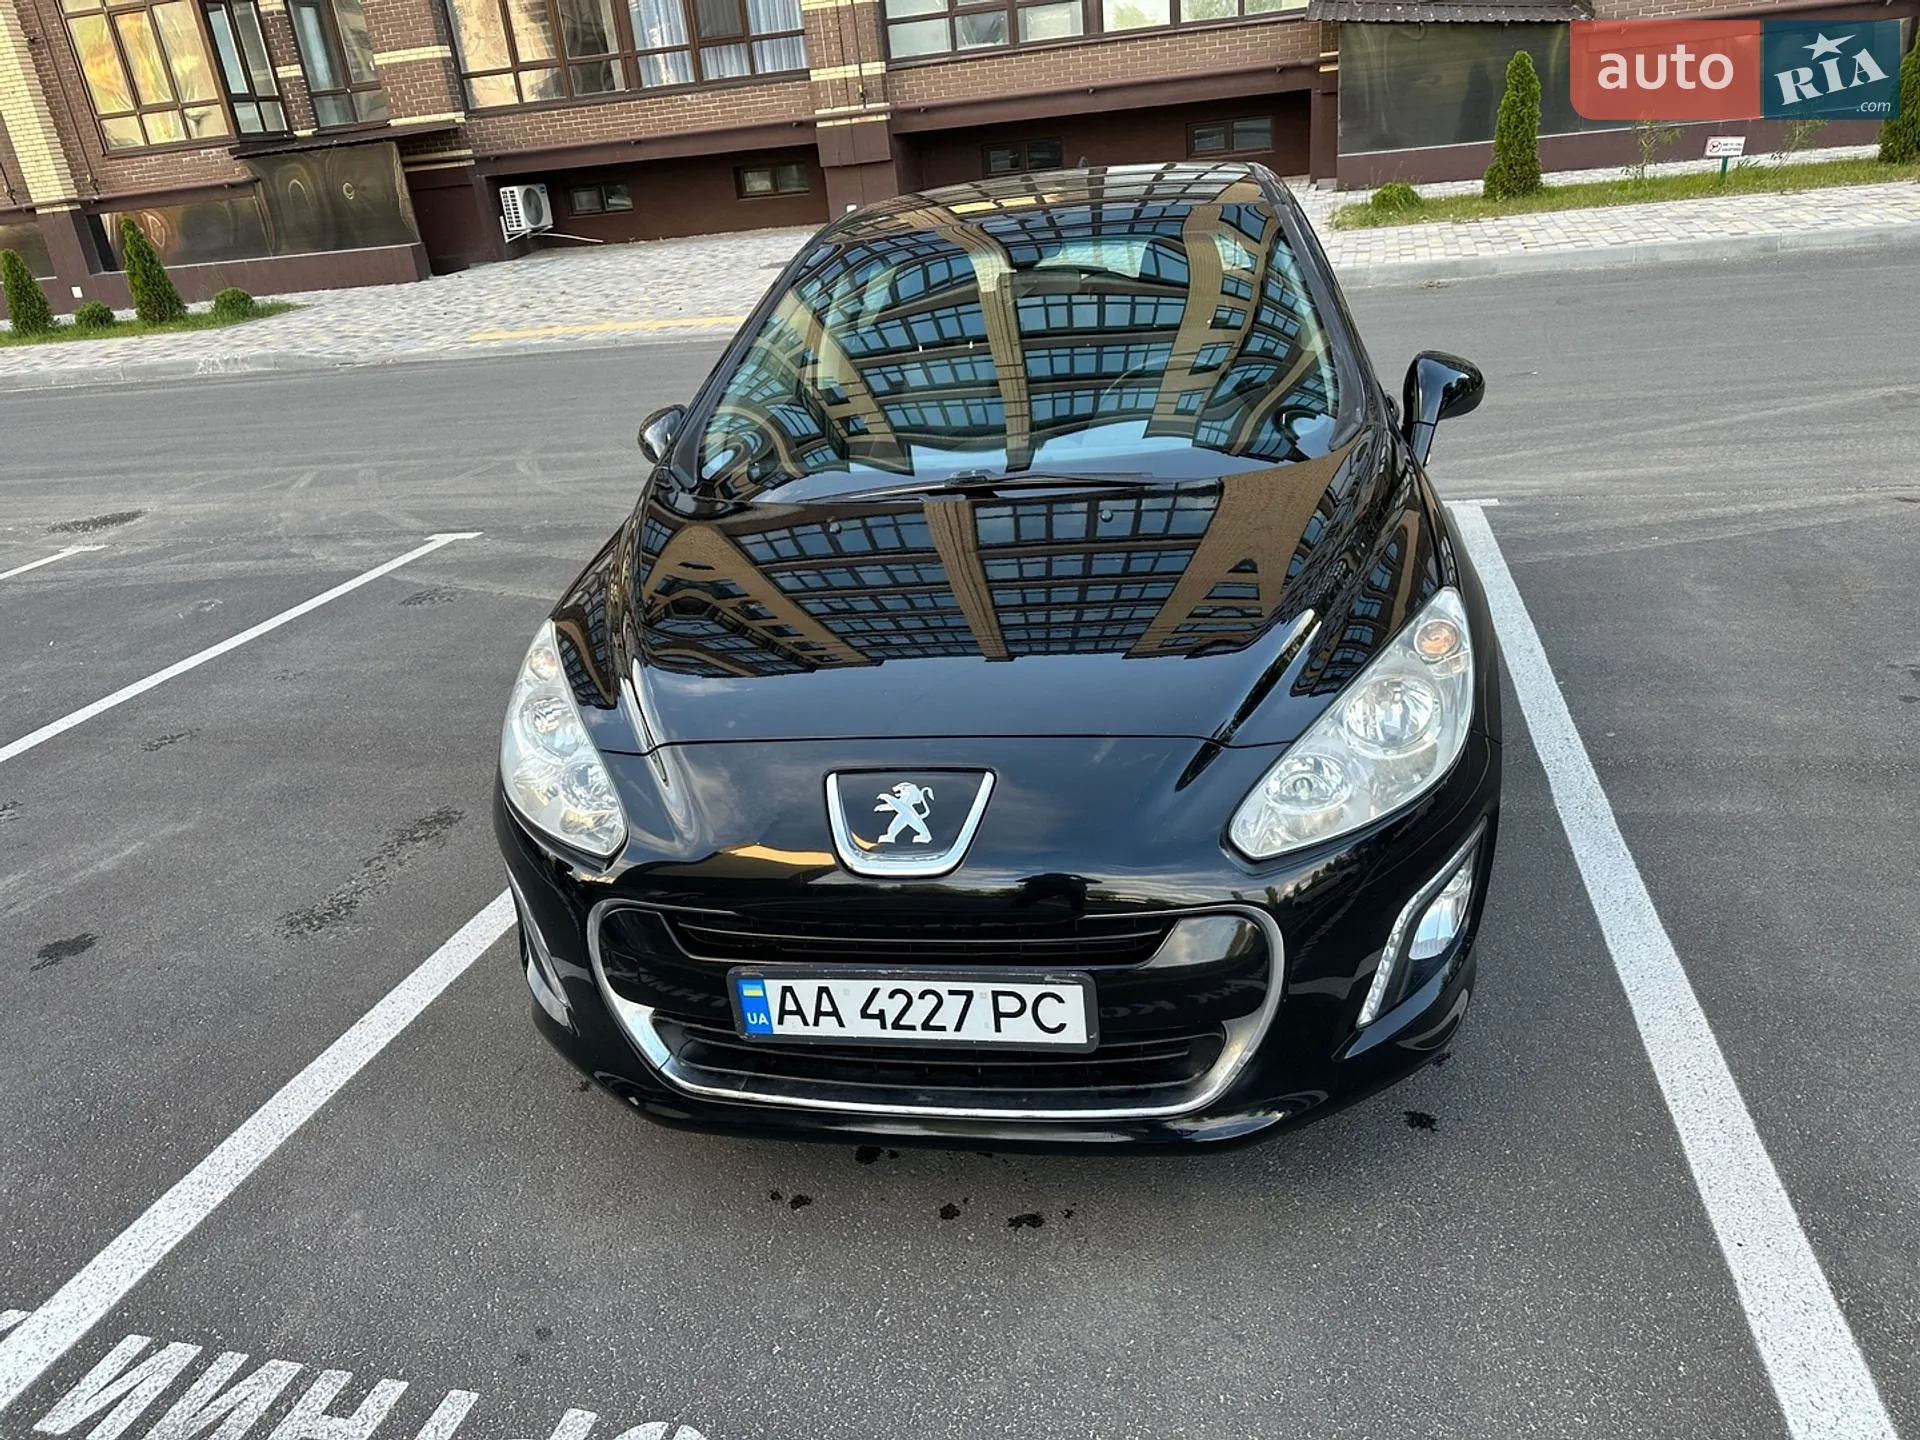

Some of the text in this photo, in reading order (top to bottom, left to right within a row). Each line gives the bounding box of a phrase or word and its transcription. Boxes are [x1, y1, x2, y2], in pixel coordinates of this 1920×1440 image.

[747, 1011, 770, 1026] UA
[777, 985, 846, 1029] AA
[859, 987, 975, 1032] 4227
[990, 989, 1068, 1035] PC
